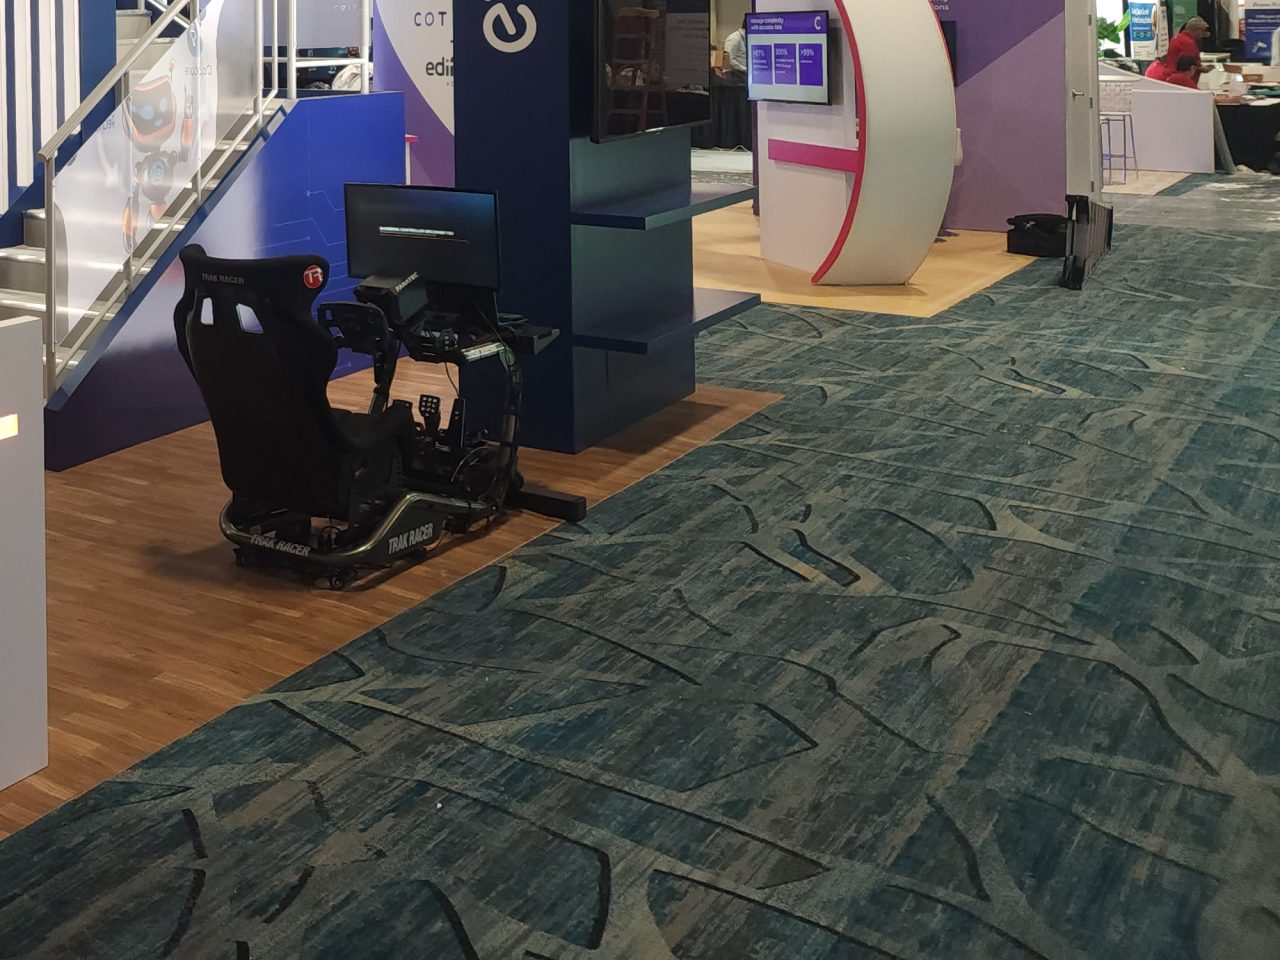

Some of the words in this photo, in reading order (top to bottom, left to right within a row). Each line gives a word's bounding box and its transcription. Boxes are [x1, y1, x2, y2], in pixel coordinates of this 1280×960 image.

[201, 272, 219, 282] TRAK
[219, 274, 245, 285] RACER
[394, 271, 420, 293] FANATEC
[250, 533, 275, 550] TRAK
[276, 539, 312, 558] RACER
[388, 532, 410, 555] TRAK
[408, 522, 434, 547] RACER
